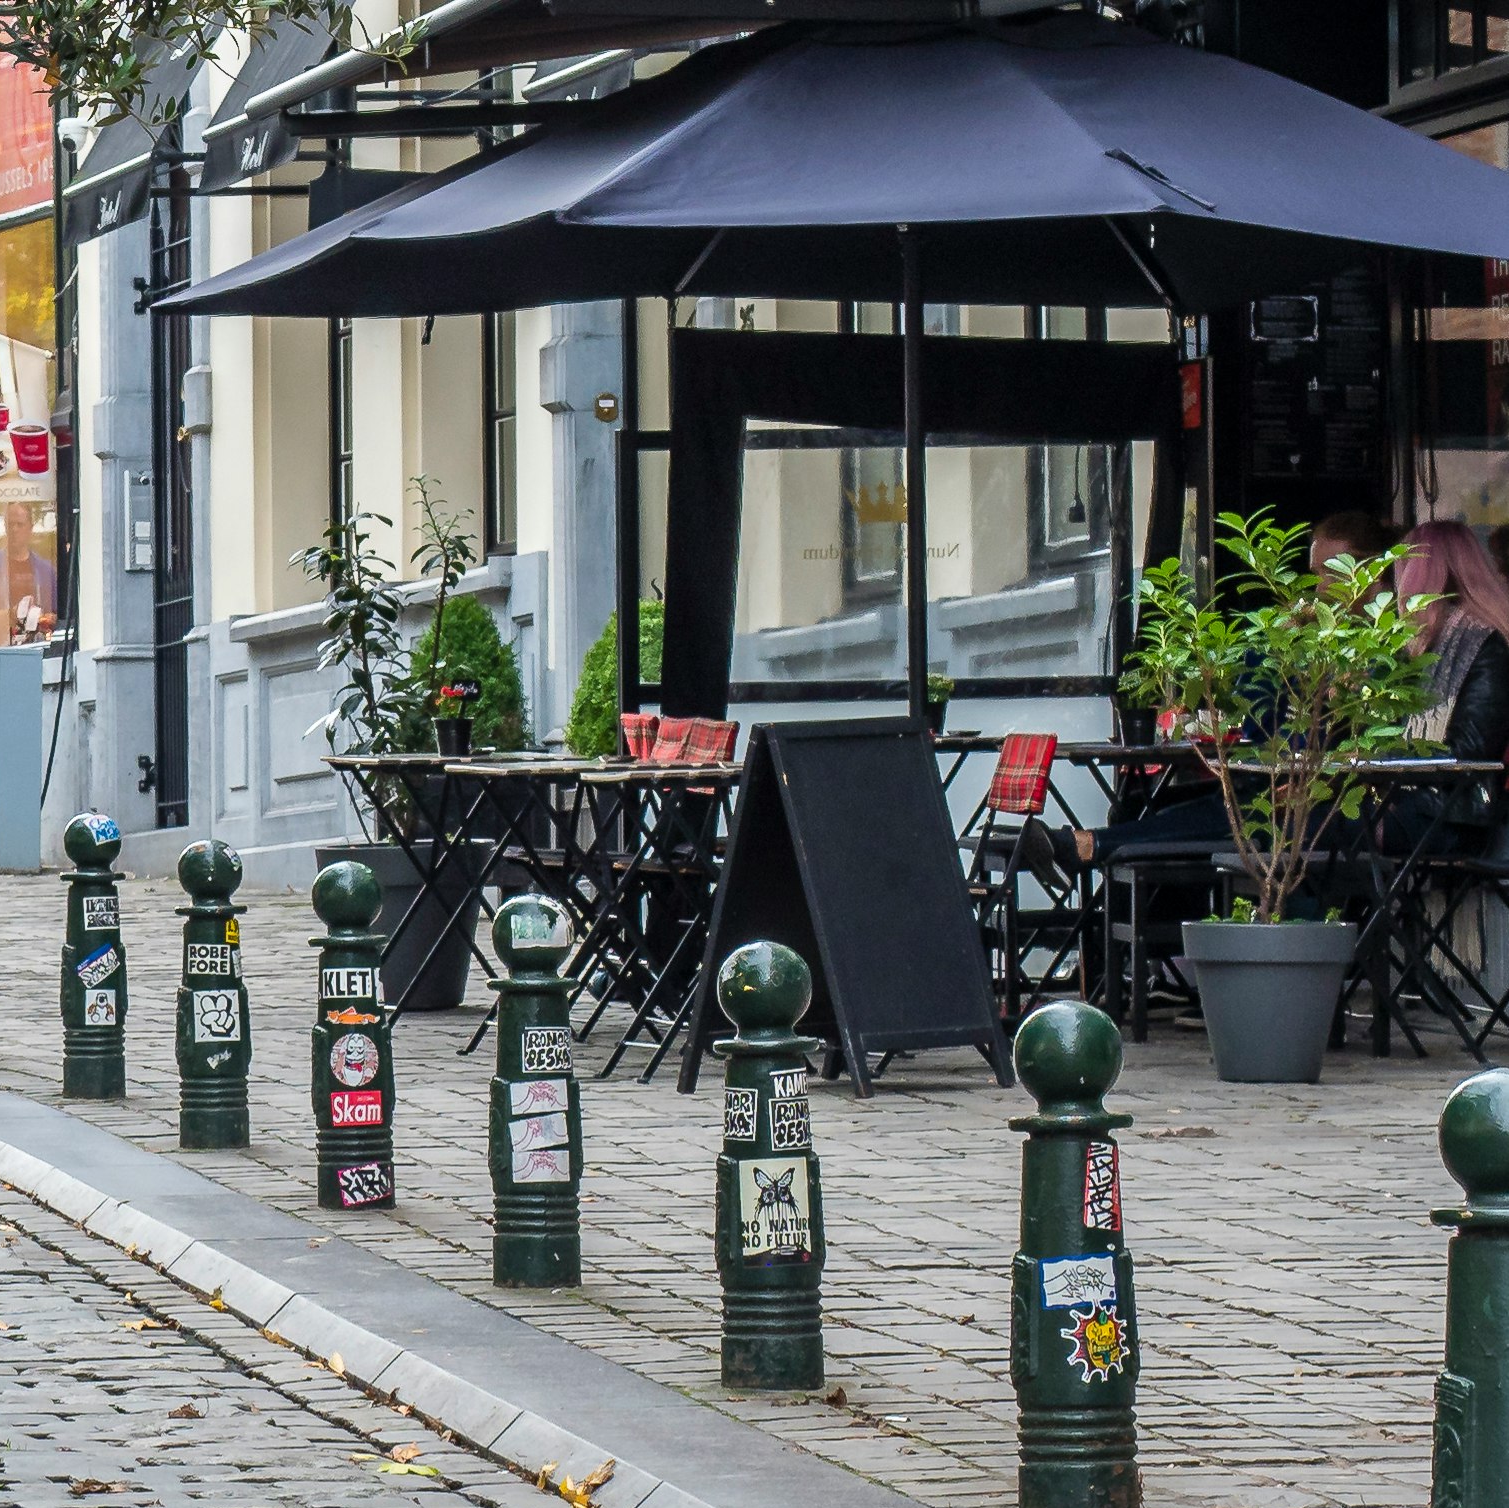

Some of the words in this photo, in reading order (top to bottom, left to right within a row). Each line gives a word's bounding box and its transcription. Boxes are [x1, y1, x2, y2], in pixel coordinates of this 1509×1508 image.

[189, 945, 229, 959] ROBE
[189, 960, 228, 974] FORE
[323, 970, 370, 997] KLET
[333, 1095, 382, 1124] Skam
[742, 1220, 761, 1234] NO
[742, 1234, 761, 1248] NO
